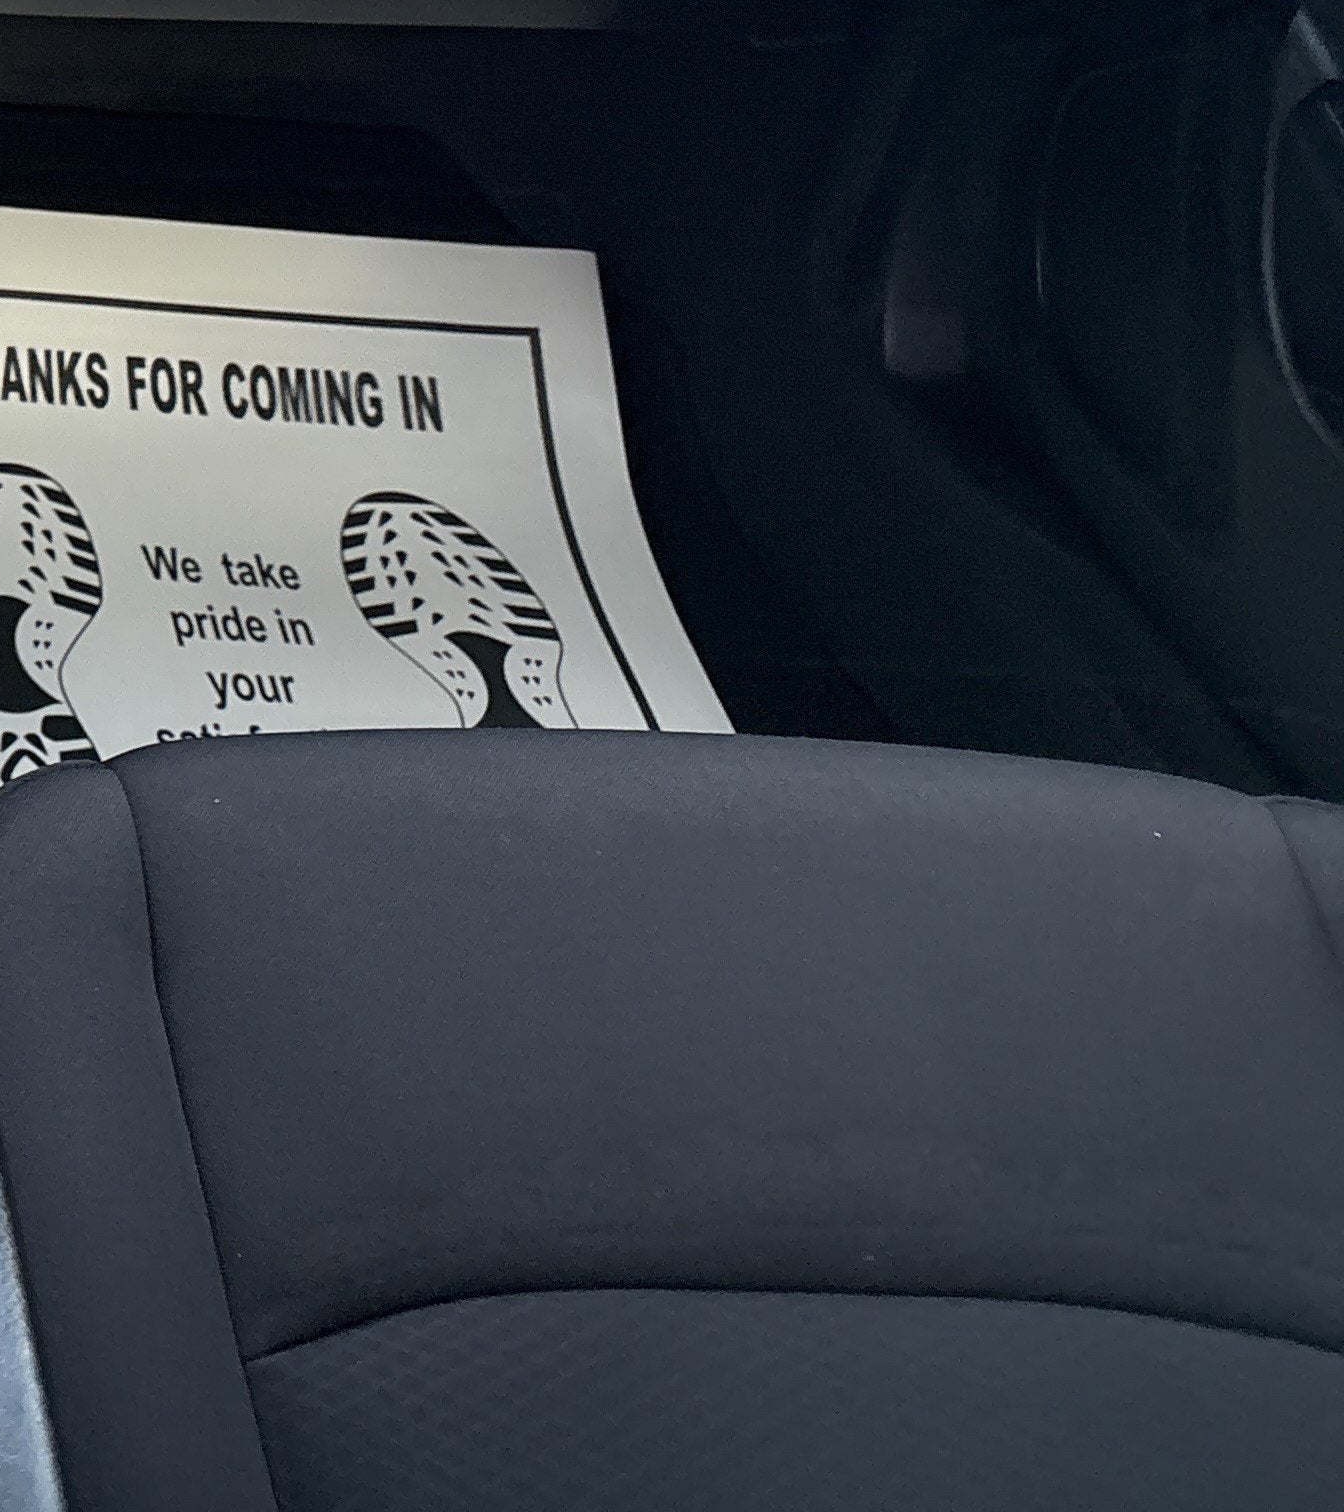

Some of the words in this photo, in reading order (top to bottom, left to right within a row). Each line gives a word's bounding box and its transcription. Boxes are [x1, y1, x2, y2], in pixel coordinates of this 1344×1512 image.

[125, 354, 208, 418] FOR
[220, 362, 385, 432] COMING
[396, 374, 446, 436] IN
[140, 543, 203, 584] We
[220, 551, 303, 591] take
[169, 604, 268, 648] pride
[273, 607, 316, 647] in
[204, 670, 295, 710] your
